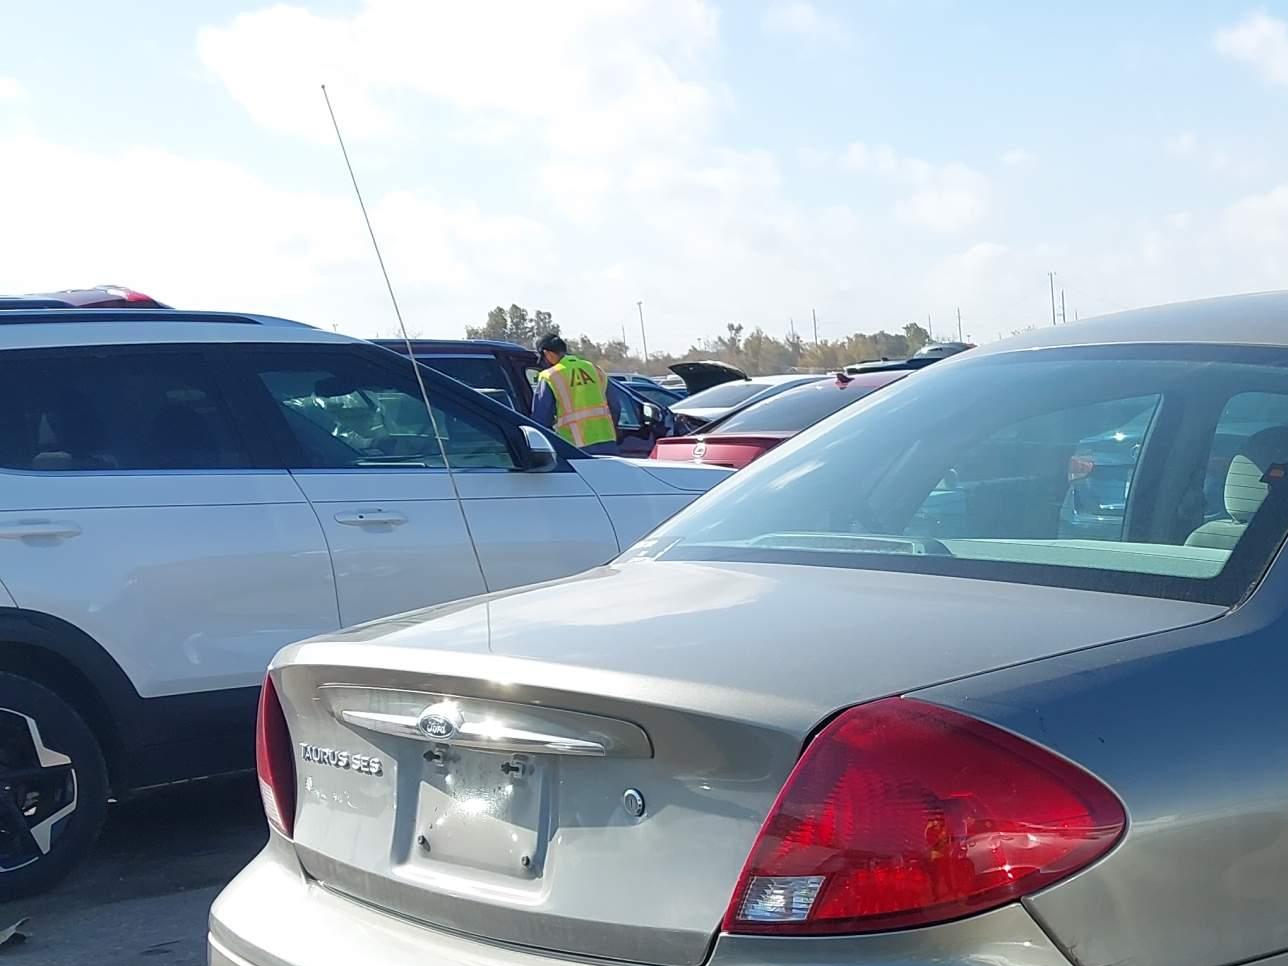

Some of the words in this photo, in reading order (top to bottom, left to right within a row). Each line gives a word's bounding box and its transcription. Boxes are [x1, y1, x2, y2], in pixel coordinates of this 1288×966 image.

[426, 718, 447, 735] Ford
[299, 743, 350, 769] TAURUS
[351, 754, 384, 777] SES
